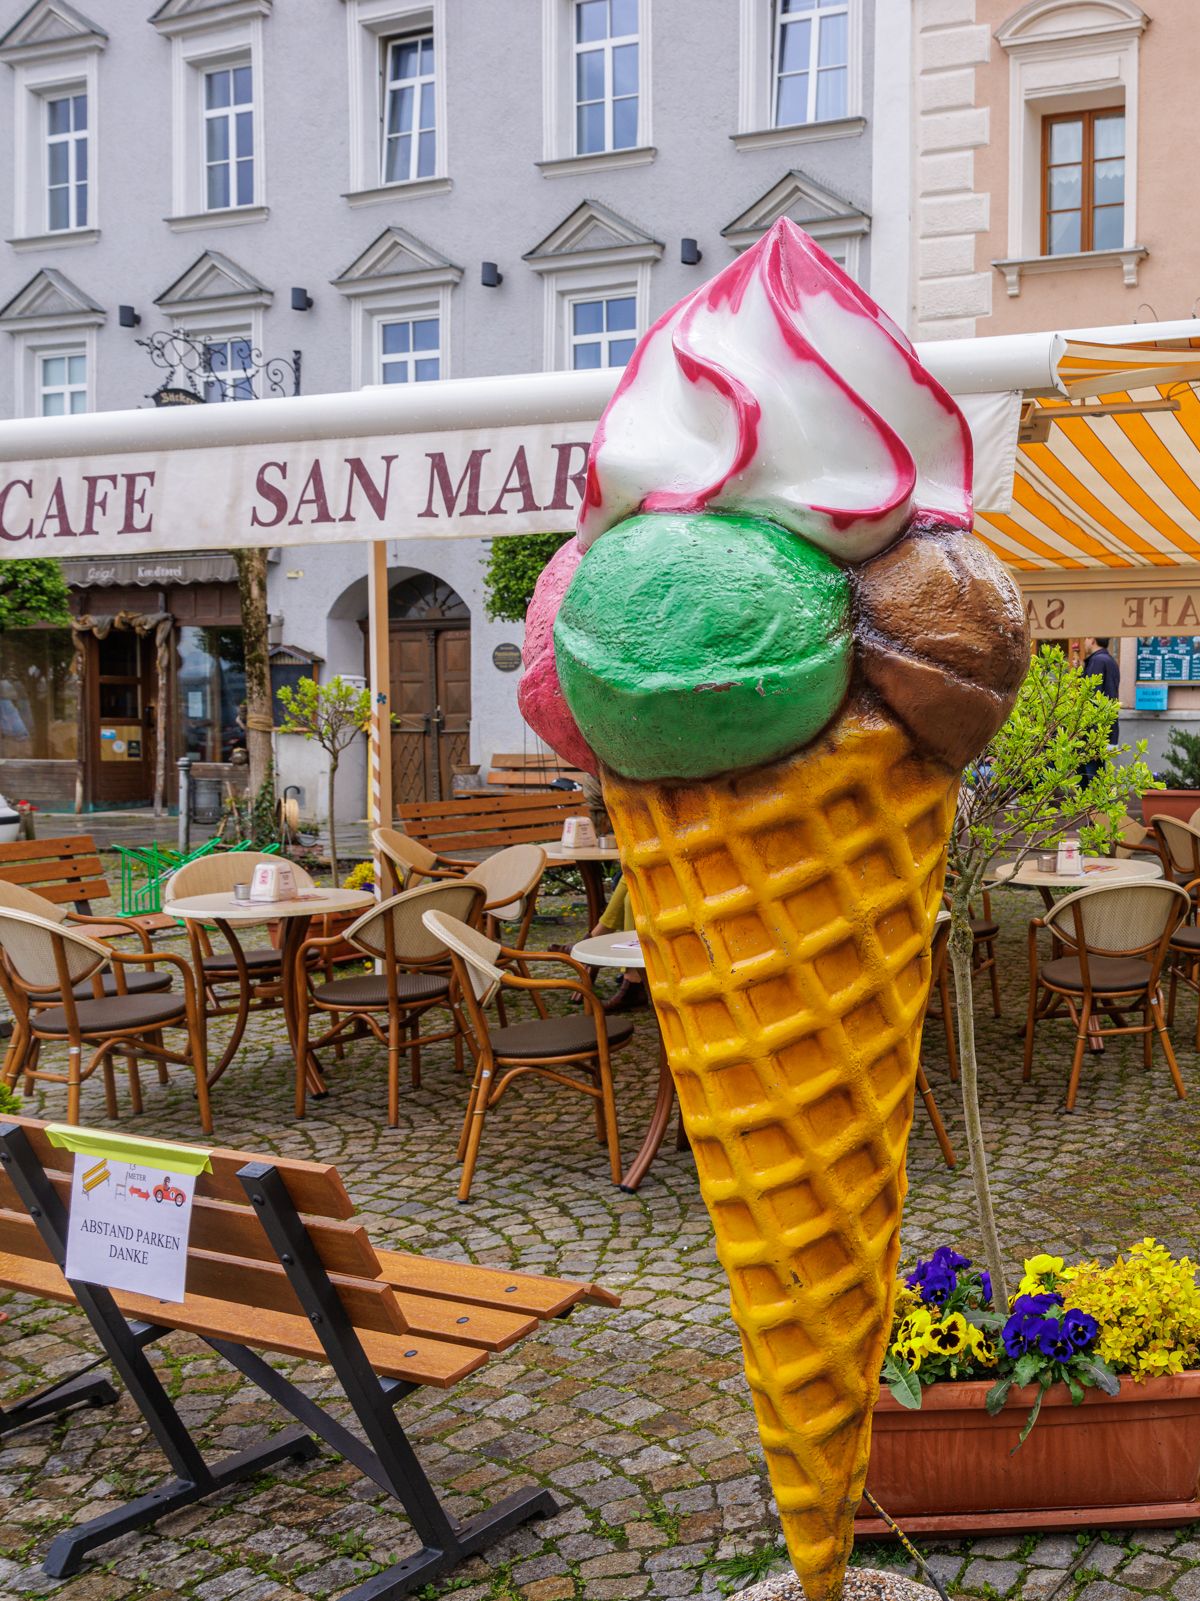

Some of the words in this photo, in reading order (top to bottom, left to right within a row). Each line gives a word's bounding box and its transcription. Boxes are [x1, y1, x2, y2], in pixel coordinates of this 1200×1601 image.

[0, 470, 156, 542] CAFE
[250, 454, 399, 527] SAN
[417, 442, 592, 518] MAR
[128, 1173, 146, 1182] METER
[80, 1218, 134, 1242] ABSTAND
[136, 1229, 181, 1251] PARKEN
[109, 1244, 149, 1266] DANKE
